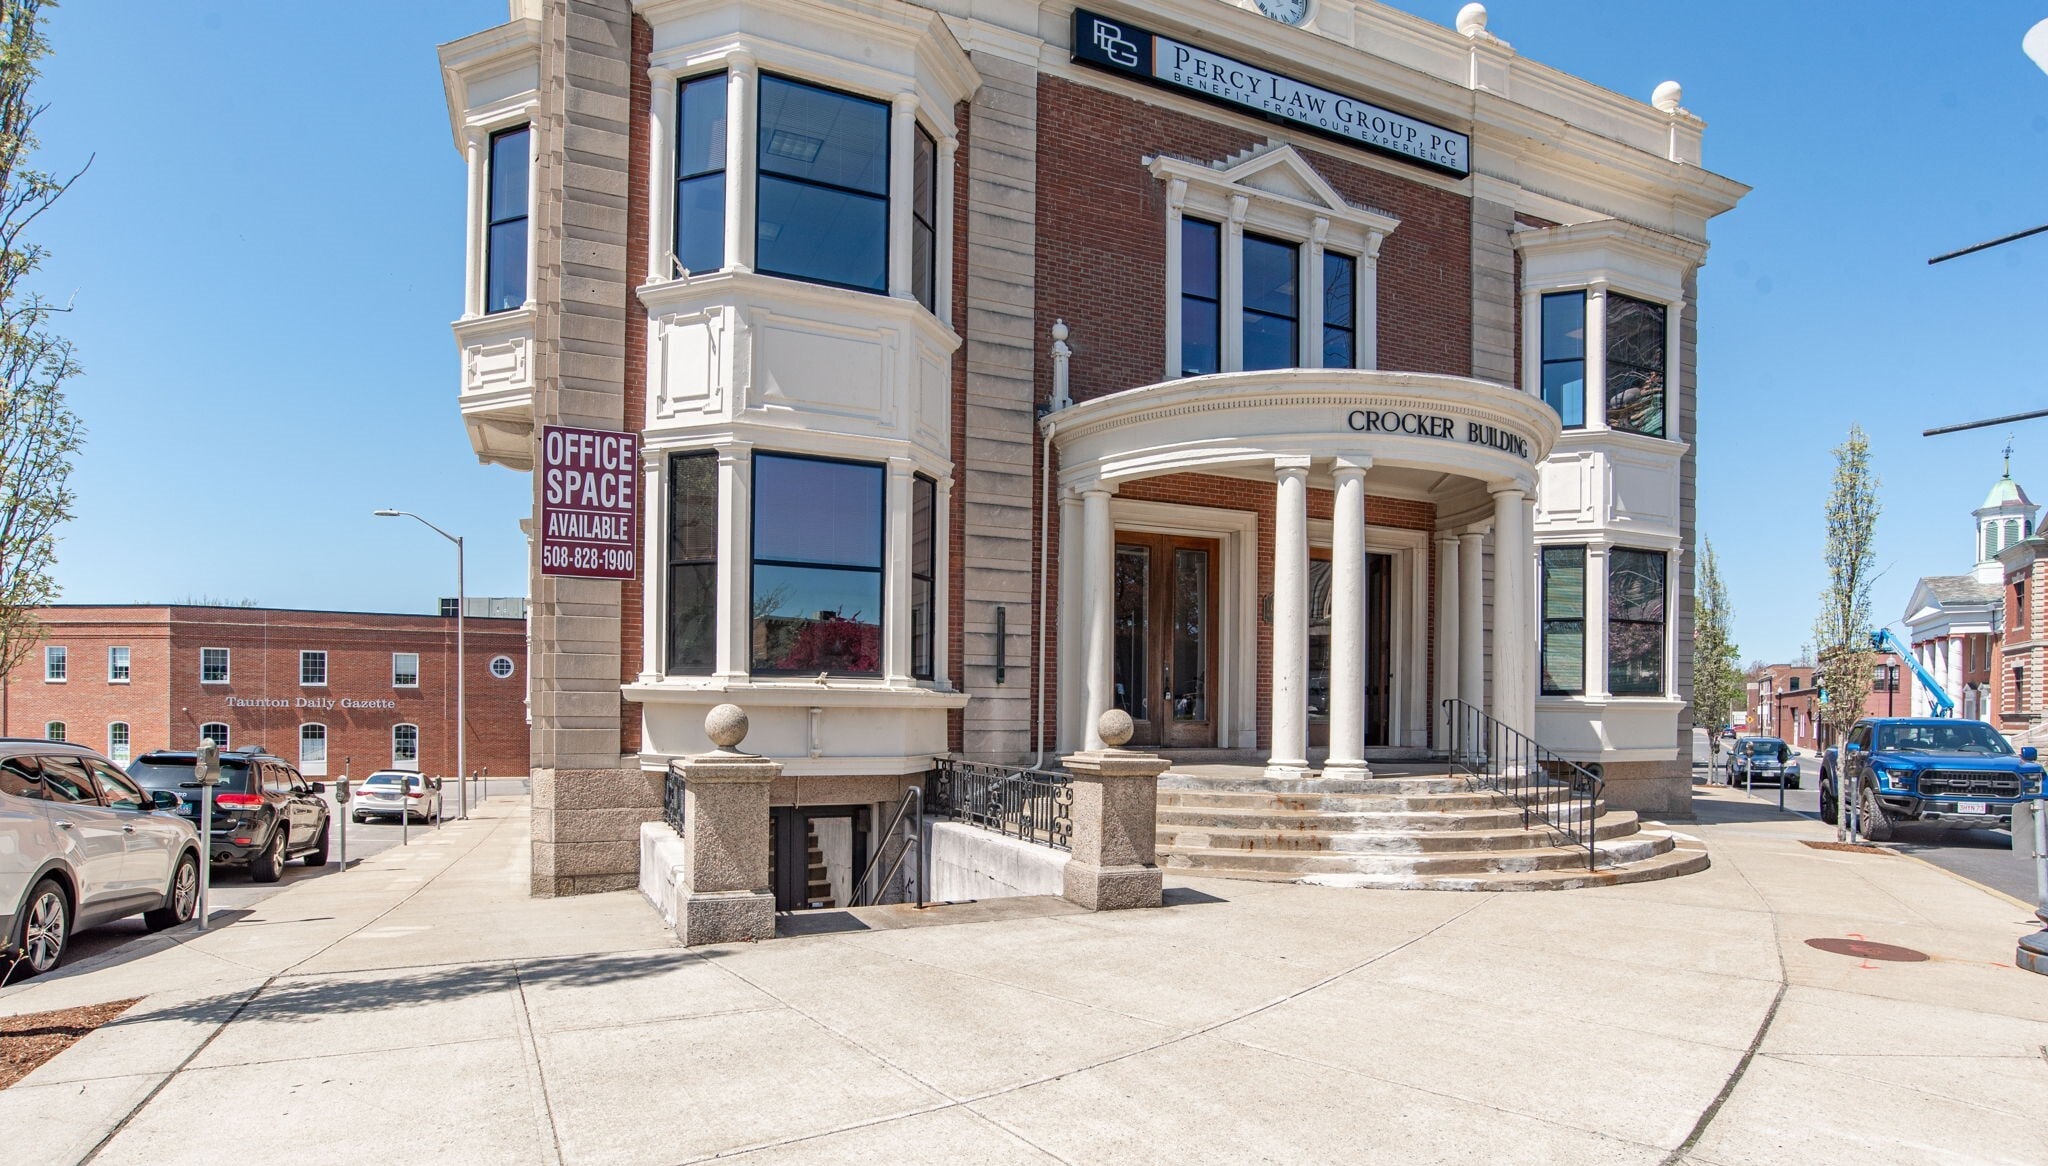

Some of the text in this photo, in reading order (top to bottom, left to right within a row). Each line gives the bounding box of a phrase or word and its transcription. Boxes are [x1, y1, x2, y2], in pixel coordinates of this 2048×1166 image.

[1173, 45, 1457, 157] PERCY LAW GROUP, PC
[1173, 72, 1457, 167] BENEFIT FROM OUR EXPERIENCE
[546, 431, 633, 471] OFFICE
[1348, 410, 1528, 458] CROCKER BUILDING
[546, 468, 632, 509] SPACE
[548, 512, 628, 541] AVAILABLE
[543, 545, 633, 571] 508-828-1900
[226, 696, 396, 711] Taunton Daily Gazette
[1919, 778, 2019, 790] FORD
